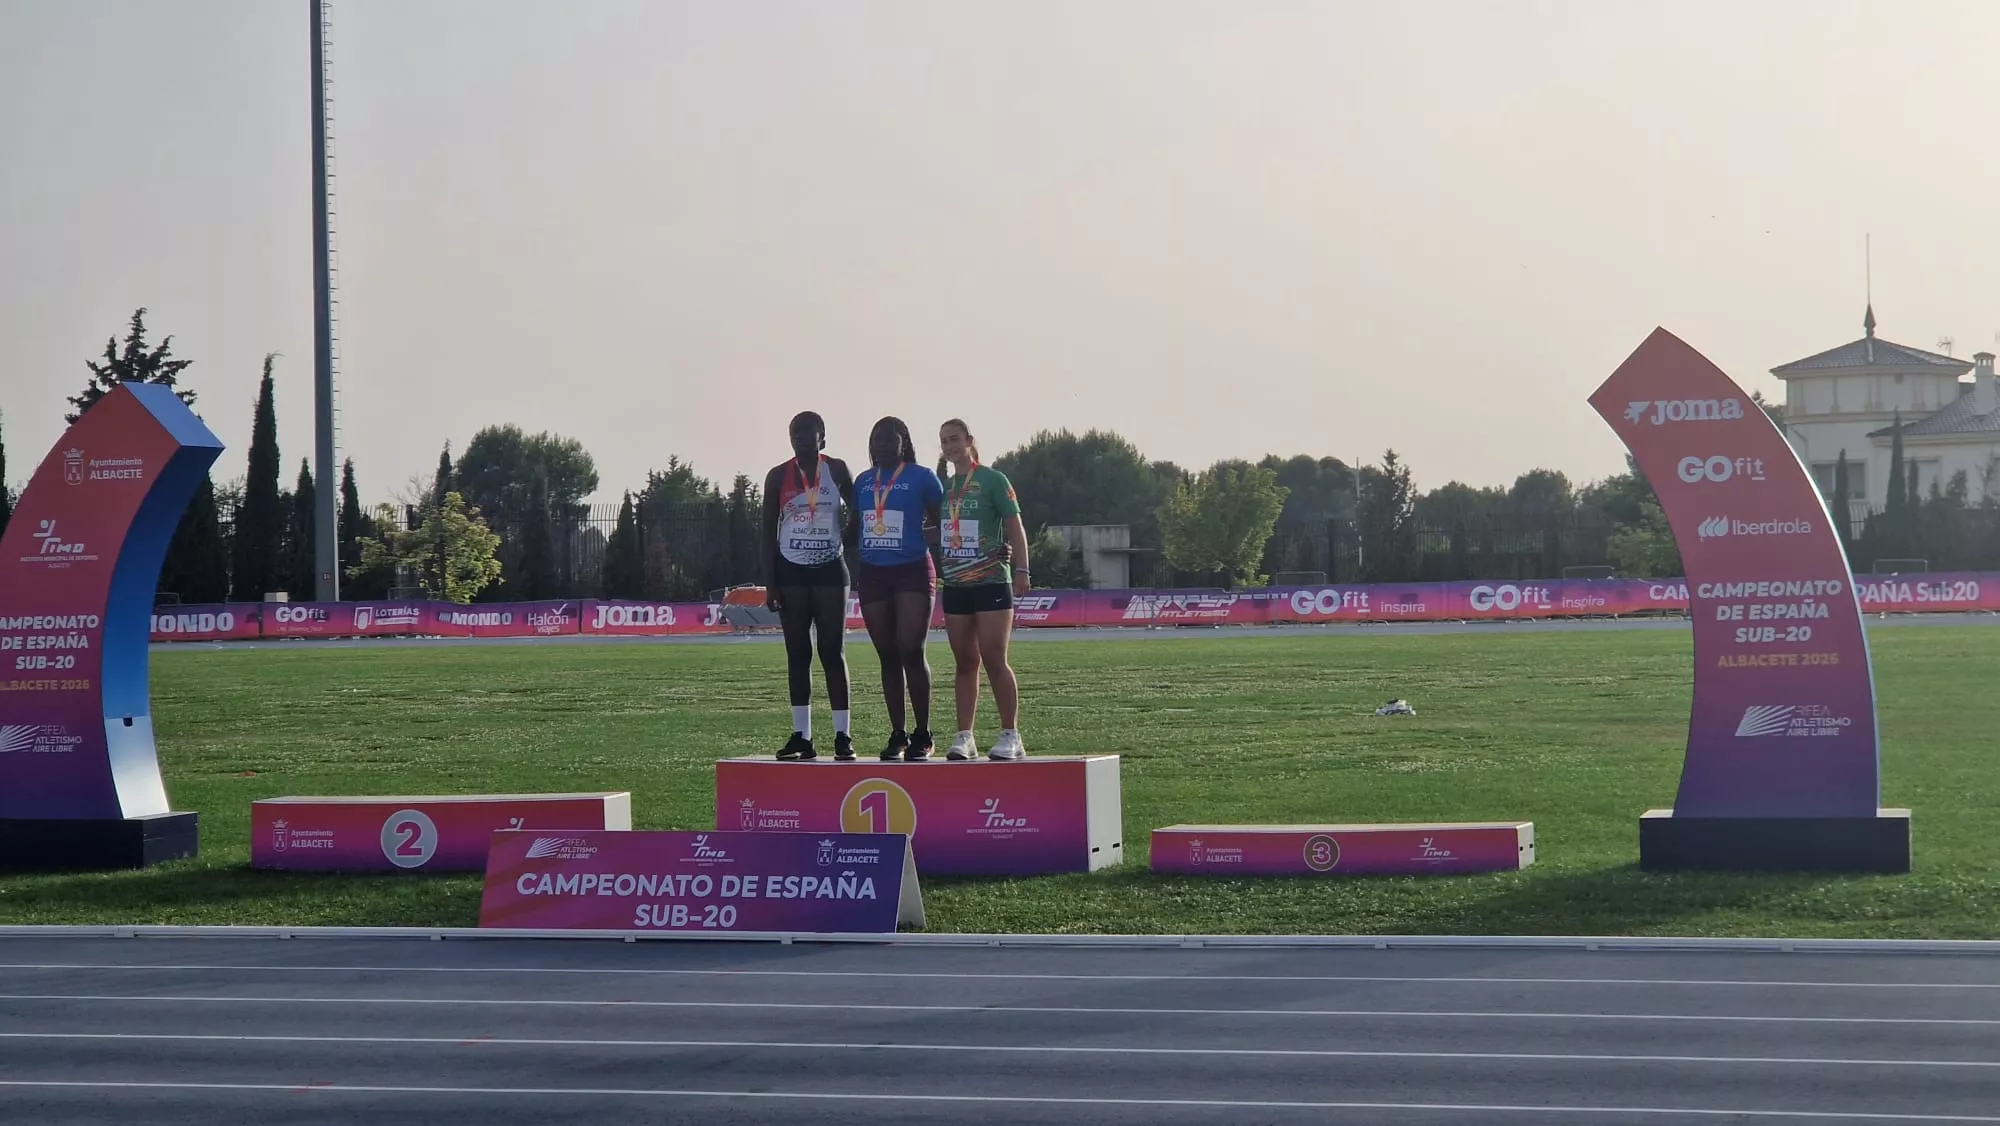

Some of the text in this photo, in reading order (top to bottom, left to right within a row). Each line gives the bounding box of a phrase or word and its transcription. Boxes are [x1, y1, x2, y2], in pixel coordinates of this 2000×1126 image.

[89, 457, 143, 468] Ayuntamiento
[89, 469, 143, 480] ALBACETE
[1732, 518, 1812, 536] Iberdrola
[1697, 580, 1842, 599] CAMPEONATO
[1855, 580, 1980, 603] PAÑA Sub20
[1380, 601, 1426, 615] inspira
[1562, 596, 1605, 609] inspira
[375, 605, 420, 617] LOTERÍAS
[1159, 609, 1230, 618] ATLETISMO
[1716, 599, 1829, 620] DE ESPAÑA
[0, 614, 99, 630] AMPEONATO
[451, 612, 513, 626] MONDO
[1, 631, 89, 650] DE ESPAÑA
[1735, 626, 1811, 643] SUB-20
[15, 655, 75, 670] SUB-20
[1717, 653, 1839, 668] ALBACETE 2026
[60, 679, 90, 690] 2026
[1789, 717, 1852, 727] ATLETISMO
[1786, 727, 1840, 737] AIRE LIBRE
[35, 735, 82, 745] ATLETISMO
[32, 744, 74, 753] AIRE LIBRE
[758, 808, 800, 818] Ayuntamiento
[859, 790, 889, 833] 1
[758, 819, 800, 829] ALBACETE
[291, 829, 333, 838] Ayuntamiento
[394, 820, 423, 858] 2
[291, 839, 334, 848] ALBACETE
[560, 846, 598, 854] ATLETISMO
[838, 846, 880, 855] Ayuntamiento
[1312, 841, 1331, 865] 3
[837, 855, 879, 864] ALBACETE
[1206, 855, 1242, 863] ALBACETE
[516, 871, 877, 899] CAMPEONATO DE ESPAÑA
[633, 904, 737, 928] SUB-20
